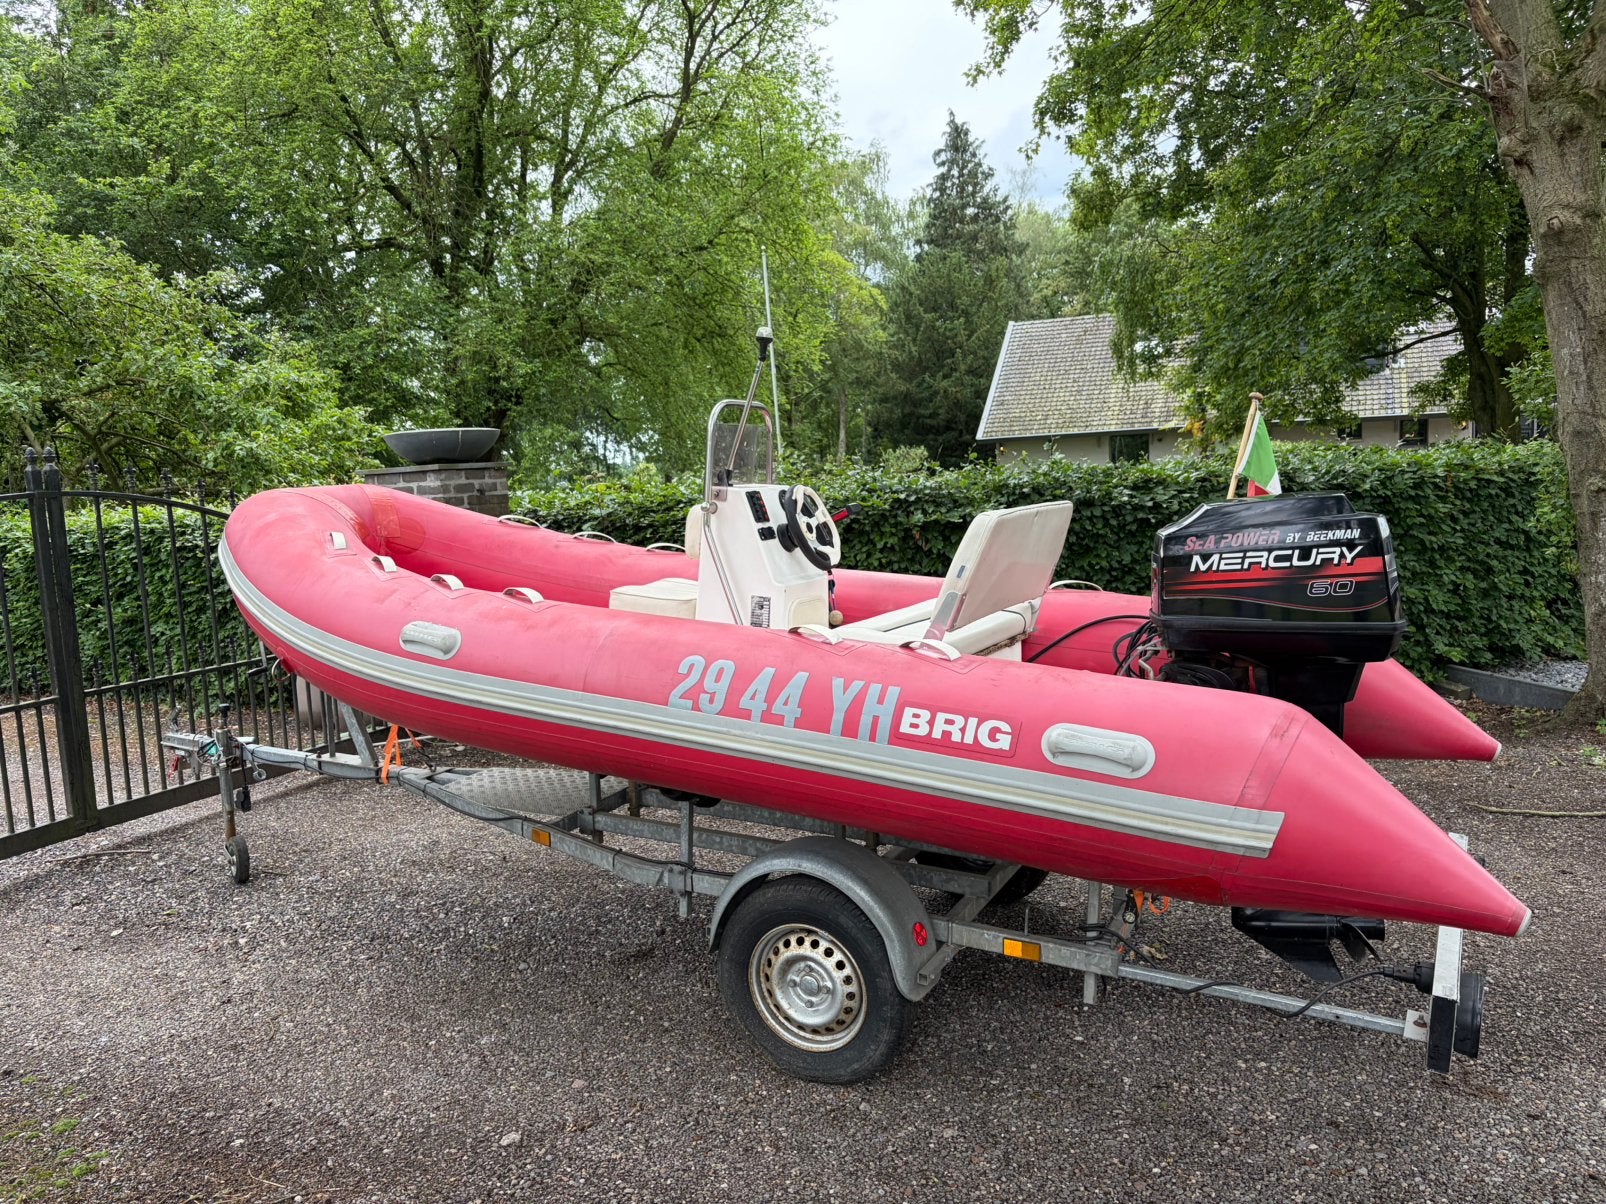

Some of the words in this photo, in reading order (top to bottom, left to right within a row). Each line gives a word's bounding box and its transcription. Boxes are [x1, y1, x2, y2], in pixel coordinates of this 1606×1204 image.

[1220, 530, 1280, 548] POWER
[1286, 533, 1301, 543] BY
[1306, 529, 1361, 542] BEEKMAN
[1190, 546, 1364, 572] MERCURY
[1307, 579, 1356, 596] 60
[830, 677, 901, 745] YH
[899, 706, 1012, 751] BRIG
